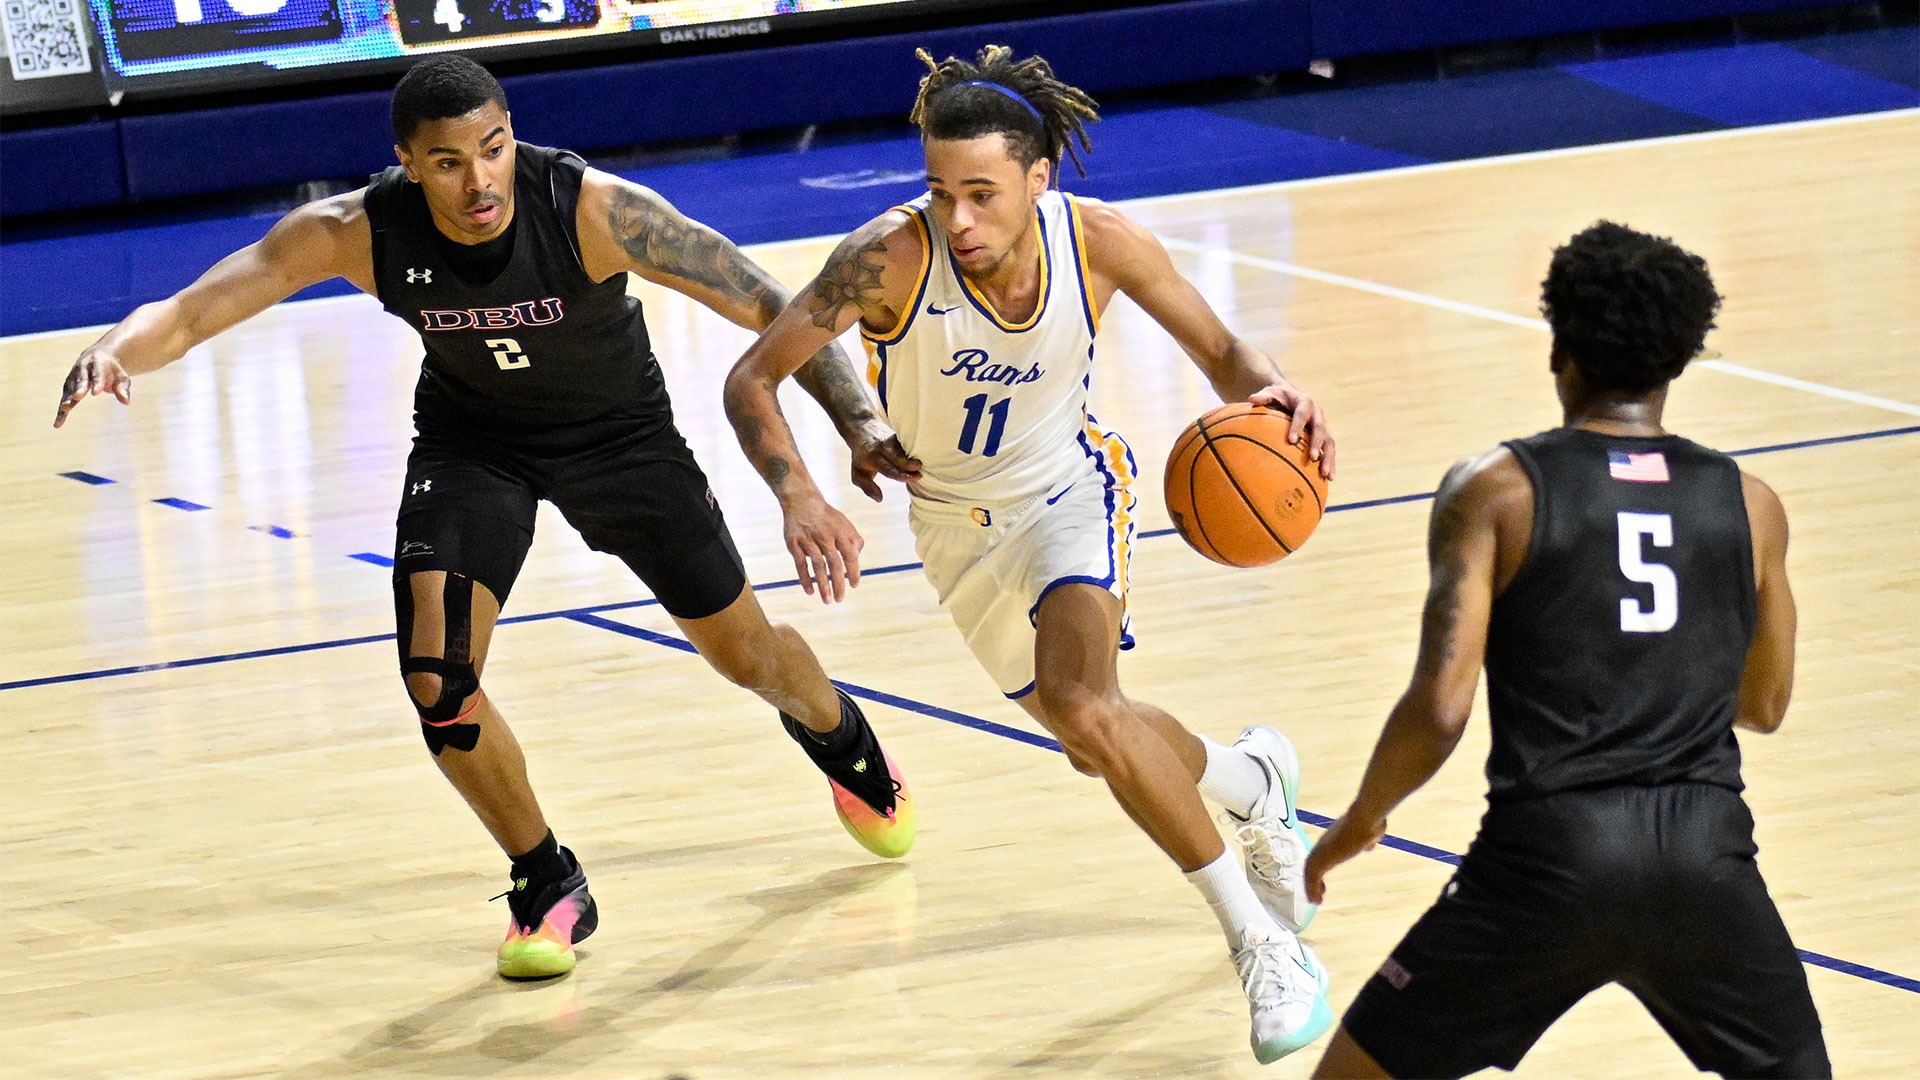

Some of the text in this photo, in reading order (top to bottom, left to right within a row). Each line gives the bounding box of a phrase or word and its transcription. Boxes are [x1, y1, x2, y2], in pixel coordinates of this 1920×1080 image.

[659, 19, 770, 44] DAKTRONICS
[420, 298, 564, 331] DBU
[484, 338, 531, 370] 2
[940, 348, 1046, 387] Rams
[957, 393, 1012, 458] 11
[1616, 511, 1678, 633] 5
